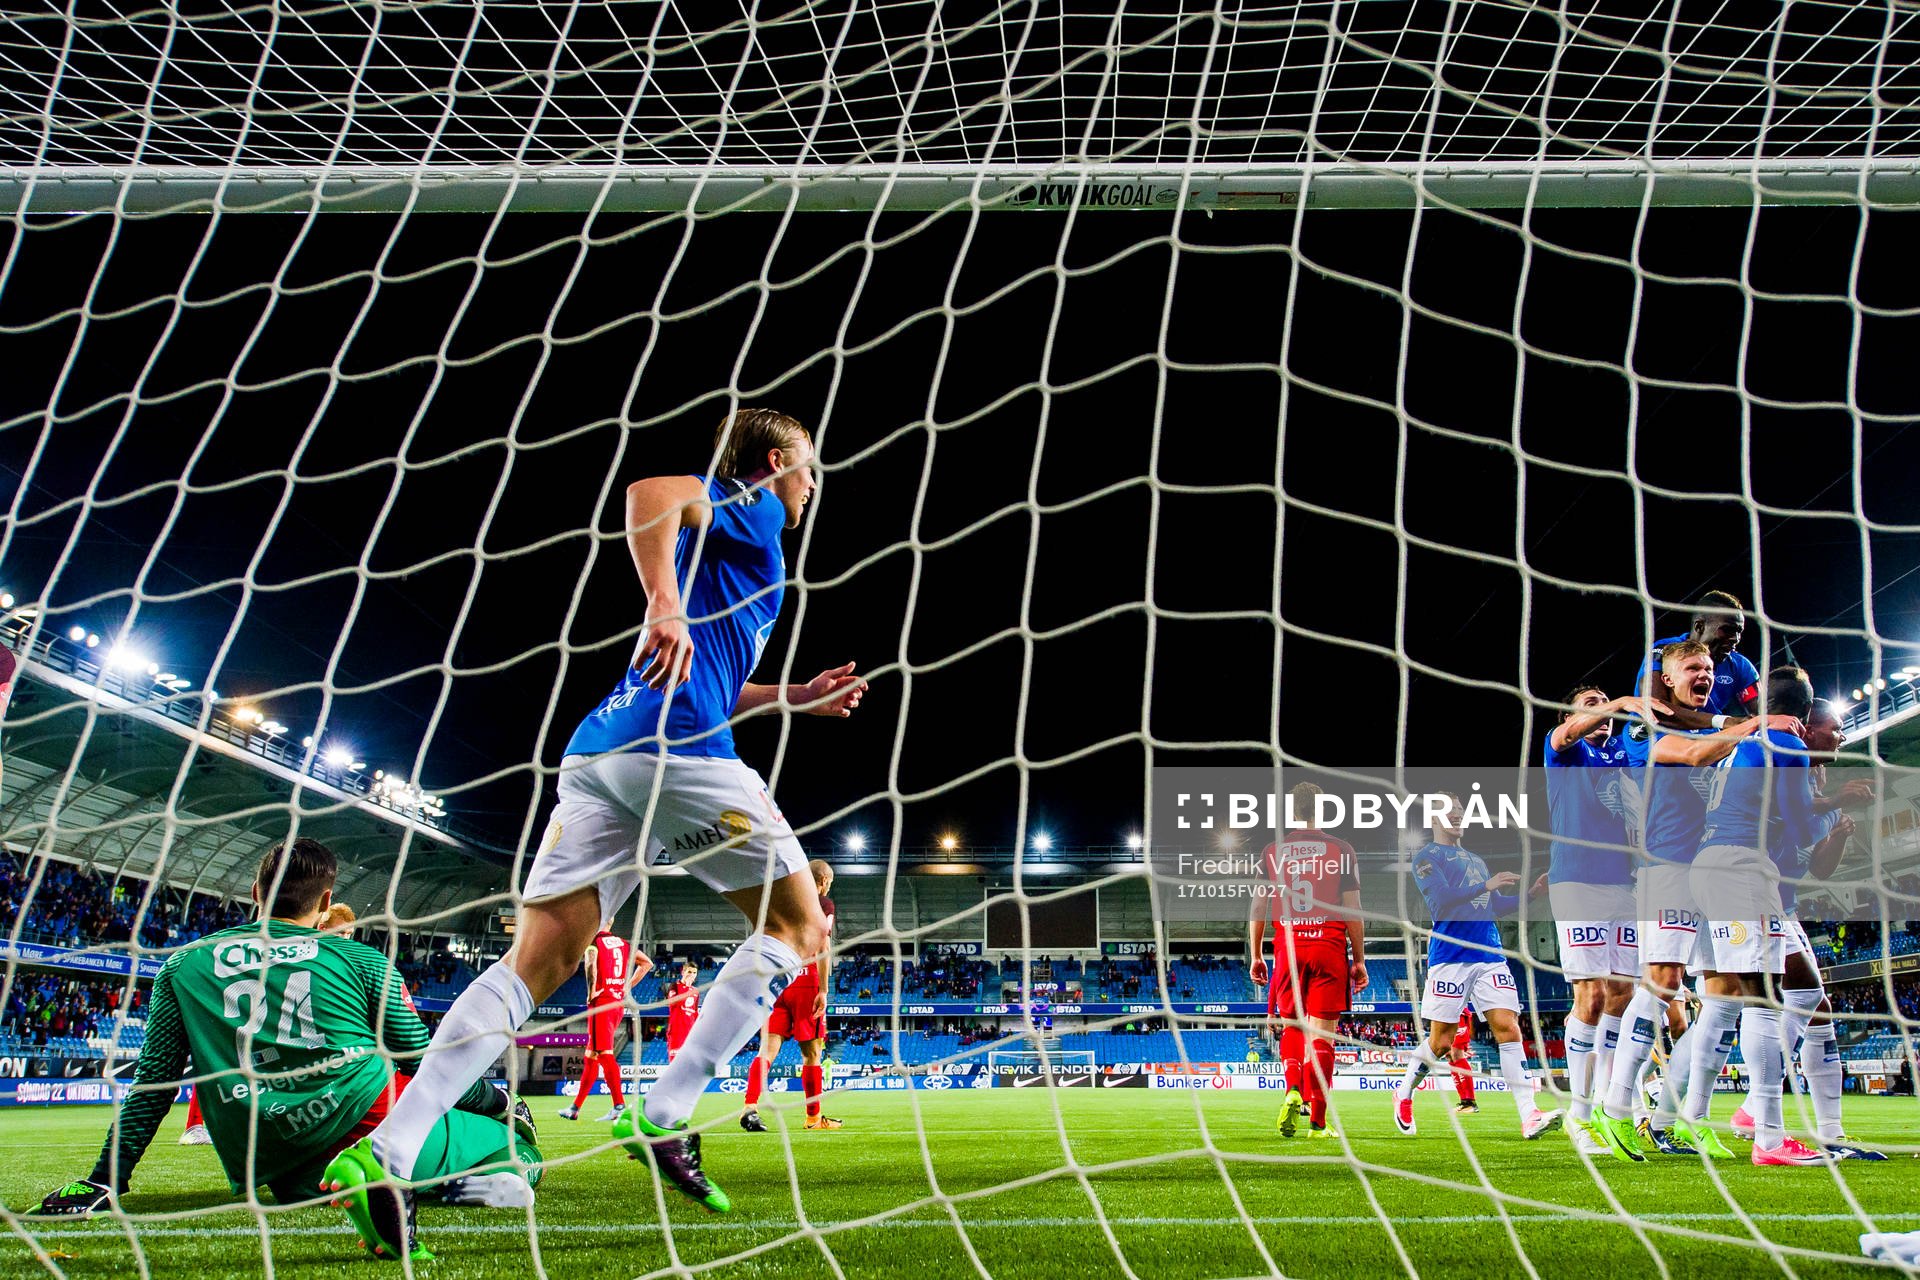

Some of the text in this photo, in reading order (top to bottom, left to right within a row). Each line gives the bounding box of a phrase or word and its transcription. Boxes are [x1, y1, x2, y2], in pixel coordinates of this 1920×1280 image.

[674, 824, 725, 850] AMFI
[219, 943, 298, 968] Chess
[938, 944, 977, 954] ISTAD
[613, 948, 623, 977] 3
[1436, 981, 1465, 995] BDO
[223, 970, 326, 1073] 24
[978, 1065, 1034, 1075] ANGVIK
[1157, 1076, 1209, 1089] Bunker
